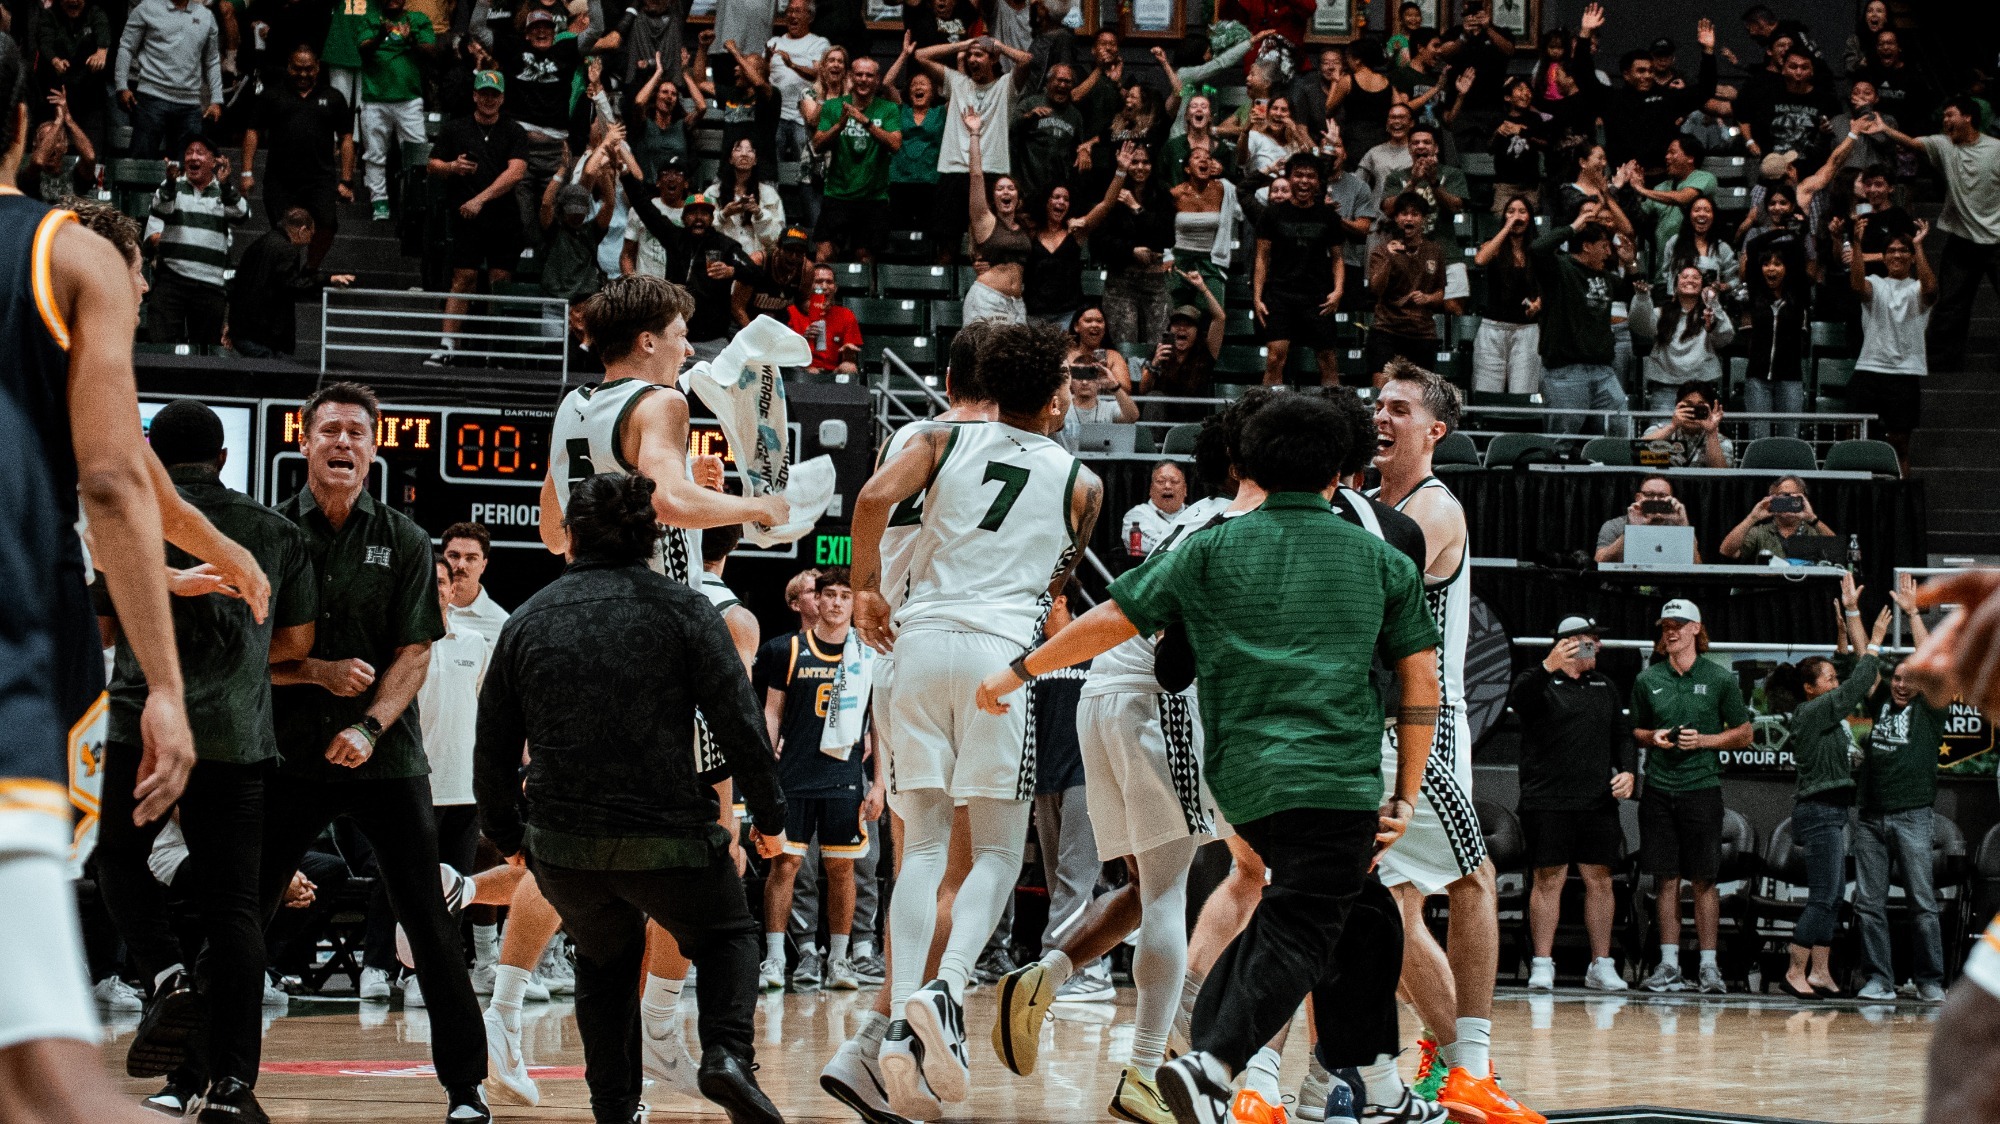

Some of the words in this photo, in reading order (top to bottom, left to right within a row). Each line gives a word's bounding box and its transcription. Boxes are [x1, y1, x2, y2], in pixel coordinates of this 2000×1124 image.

[504, 409, 556, 418] DAKTRONI
[977, 460, 1031, 533] 7
[816, 535, 852, 565] EXIT
[797, 667, 836, 679] ANTEA
[1949, 703, 1982, 716] NAL
[1732, 751, 1776, 765] YOUR
